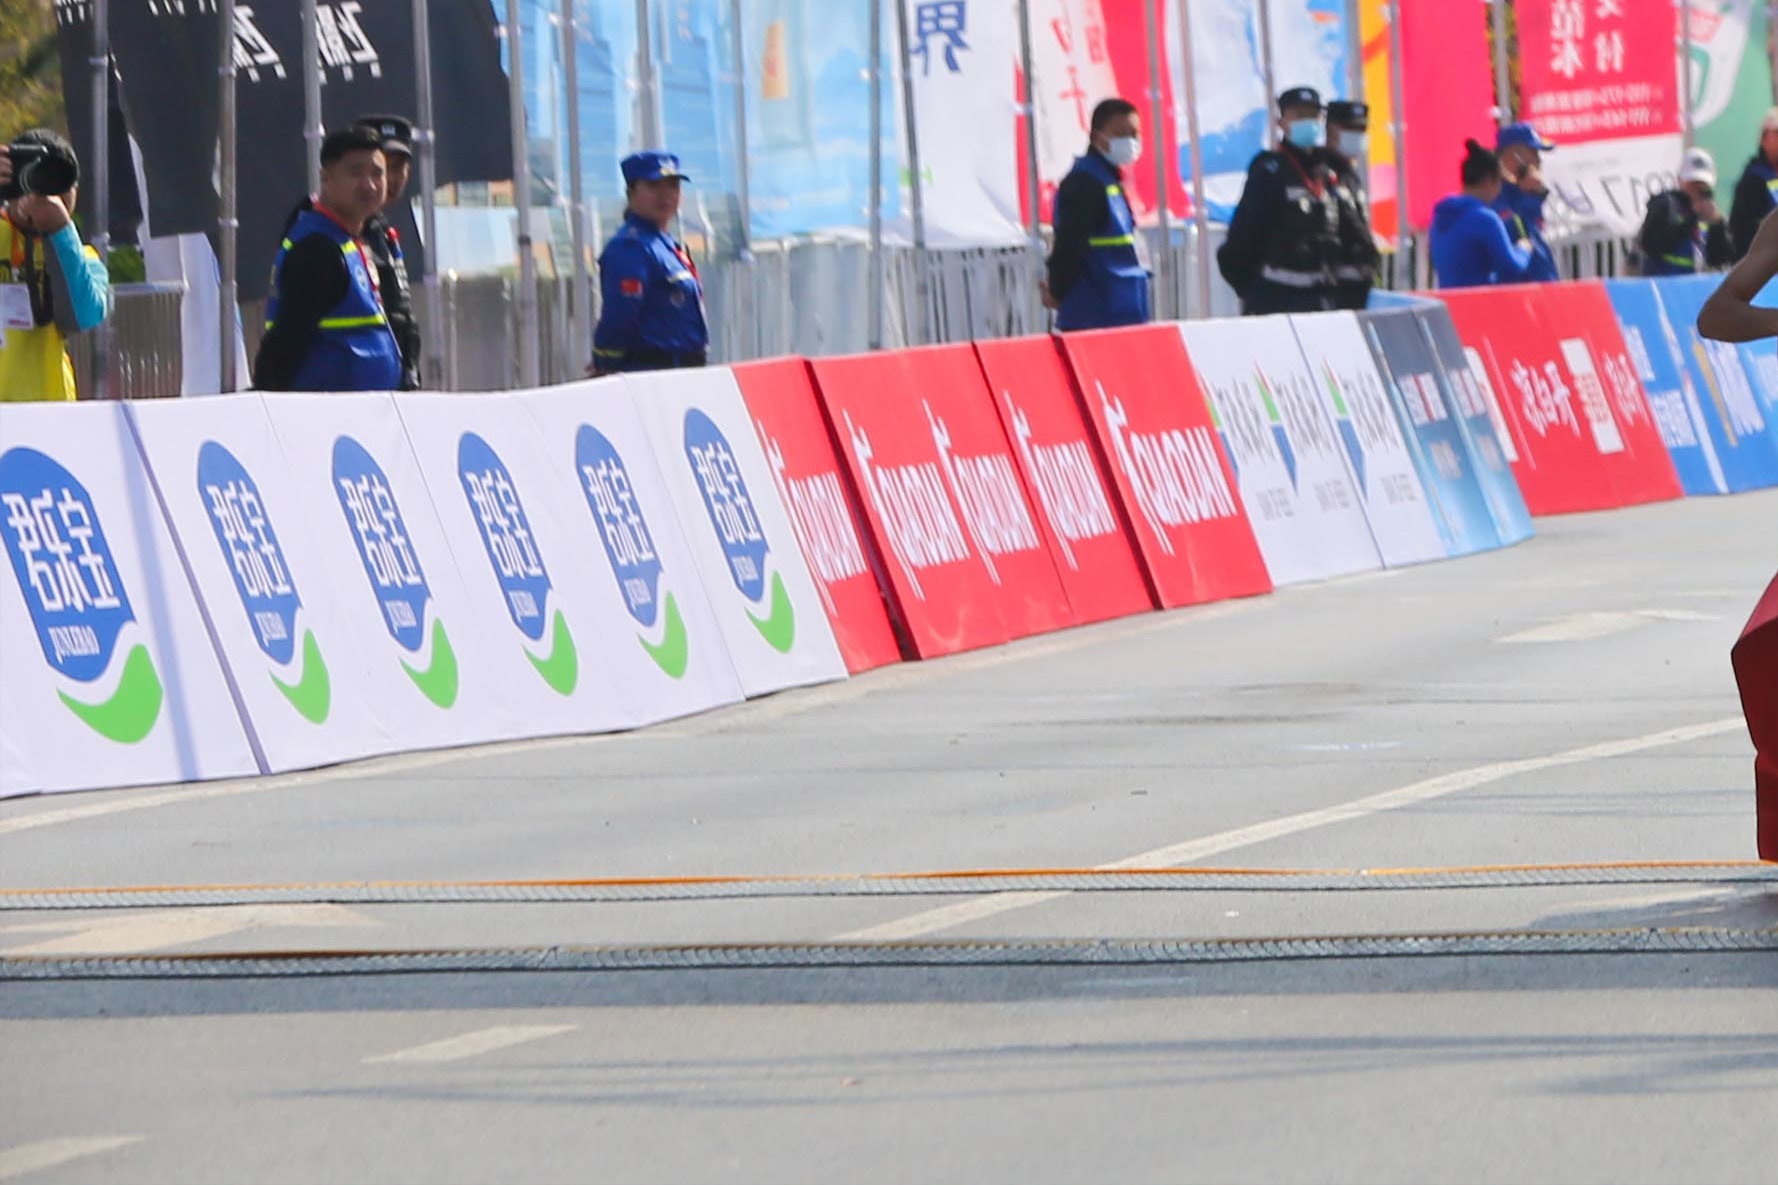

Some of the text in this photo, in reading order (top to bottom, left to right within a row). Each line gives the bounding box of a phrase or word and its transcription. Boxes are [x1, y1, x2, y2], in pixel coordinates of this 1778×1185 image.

[2, 488, 121, 613] 君乐宝
[206, 480, 292, 599] 君乐宝
[338, 472, 424, 589] 君乐宝
[464, 468, 544, 581] 君乐宝
[582, 458, 656, 566] 君乐宝
[690, 441, 764, 546] 君乐宝
